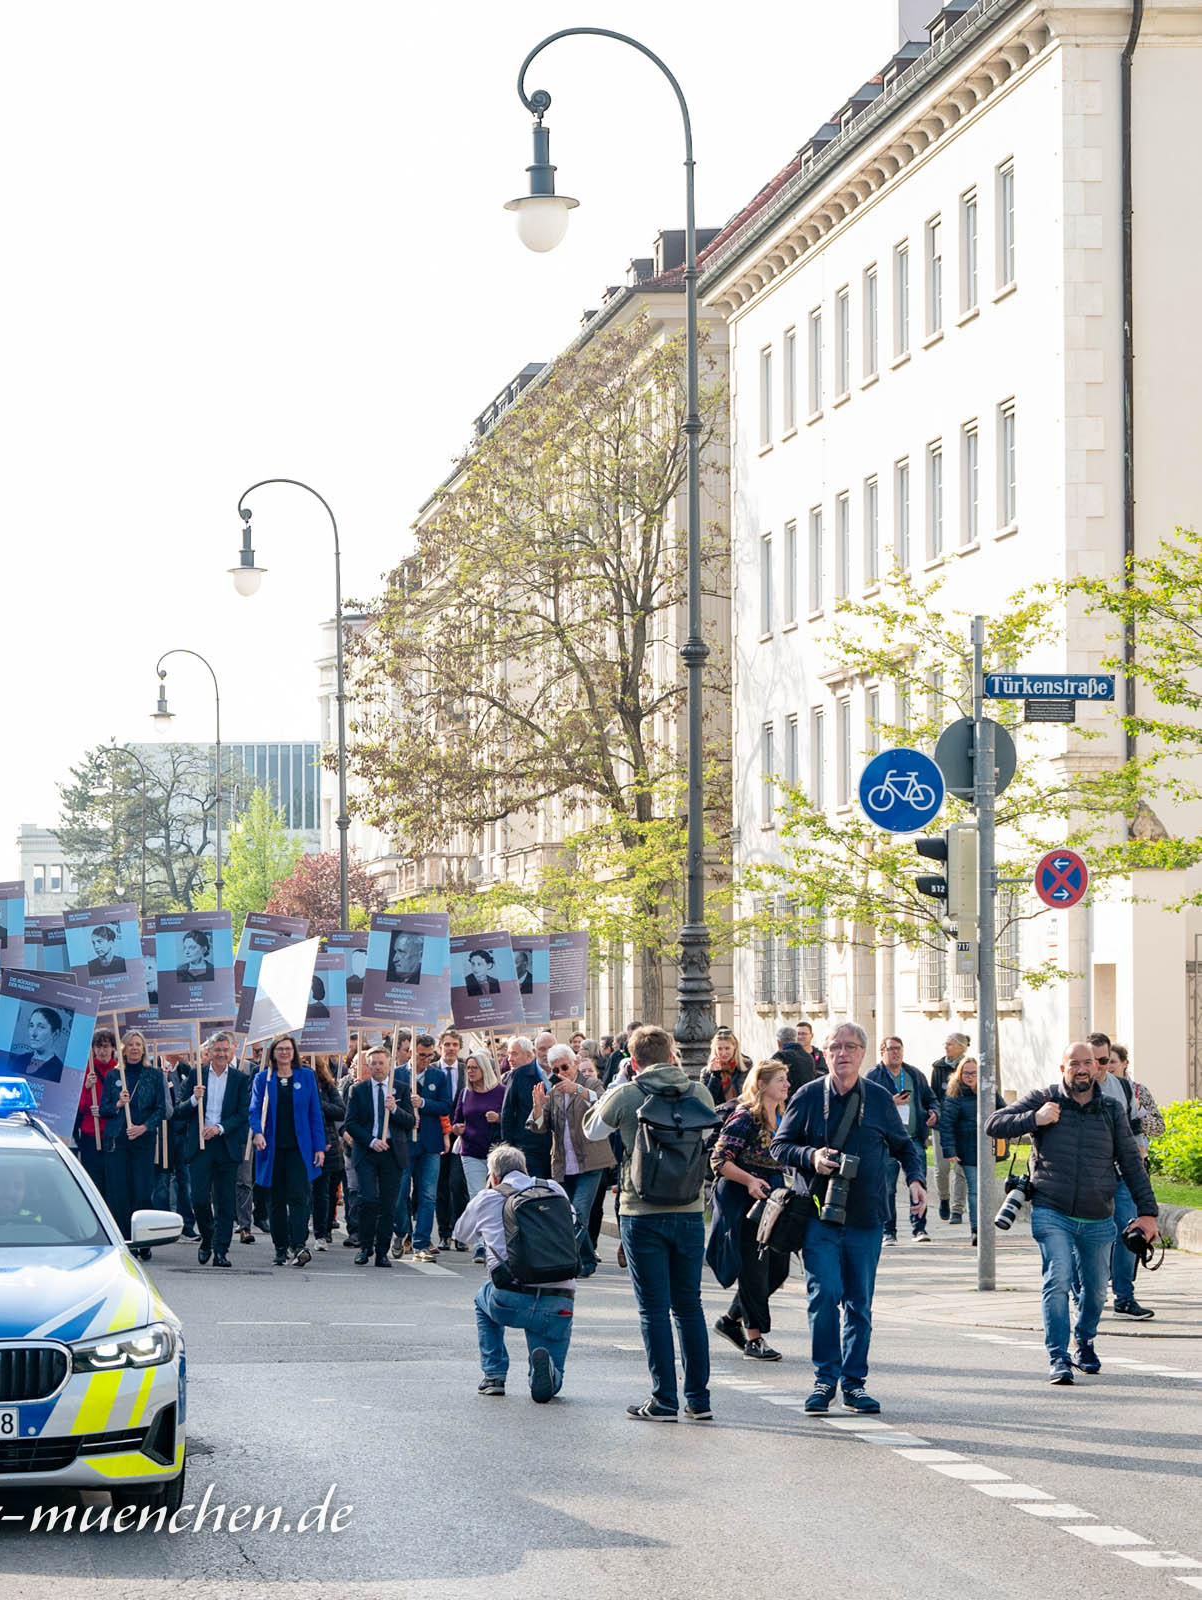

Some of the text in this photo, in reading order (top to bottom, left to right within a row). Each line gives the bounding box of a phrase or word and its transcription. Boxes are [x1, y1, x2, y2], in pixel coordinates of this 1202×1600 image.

[991, 676, 1108, 698] Türkenstraße
[931, 885, 946, 893] 512
[17, 977, 40, 988] RÜCKKEHR
[16, 983, 35, 993] NAMEN
